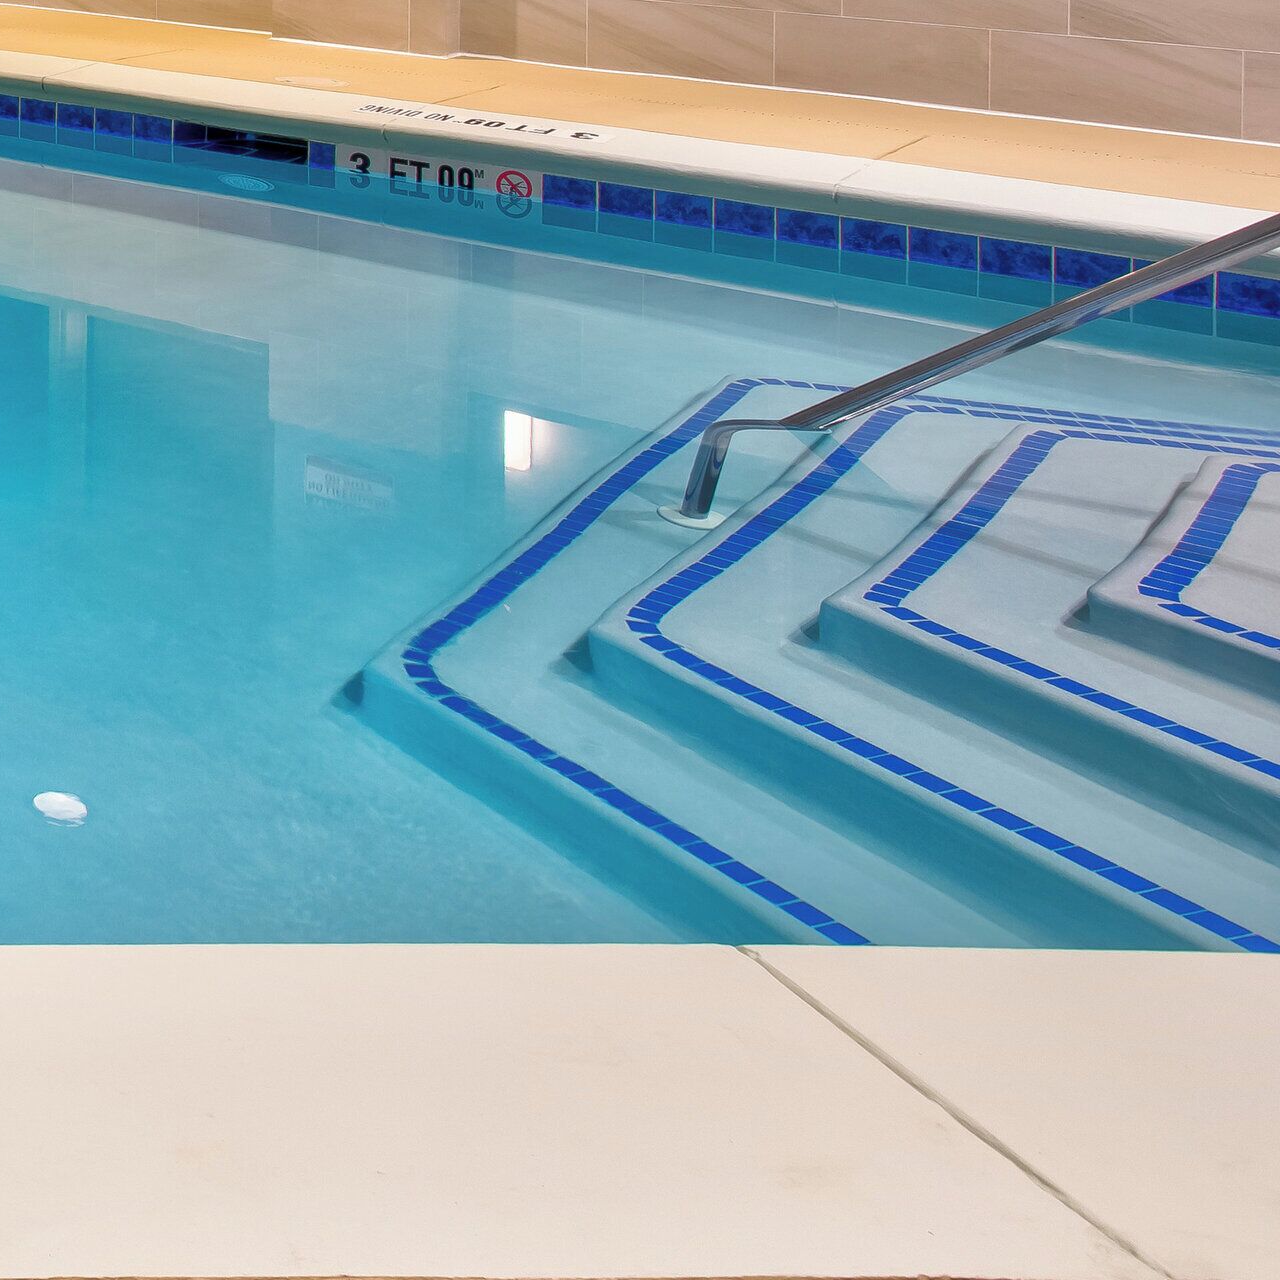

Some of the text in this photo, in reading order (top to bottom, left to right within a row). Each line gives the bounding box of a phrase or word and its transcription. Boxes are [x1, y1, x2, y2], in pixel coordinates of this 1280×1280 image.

[359, 104, 423, 117] DIVING
[424, 112, 455, 123] NO
[504, 124, 557, 135] FT
[570, 131, 600, 140] 3
[349, 152, 371, 174] 3
